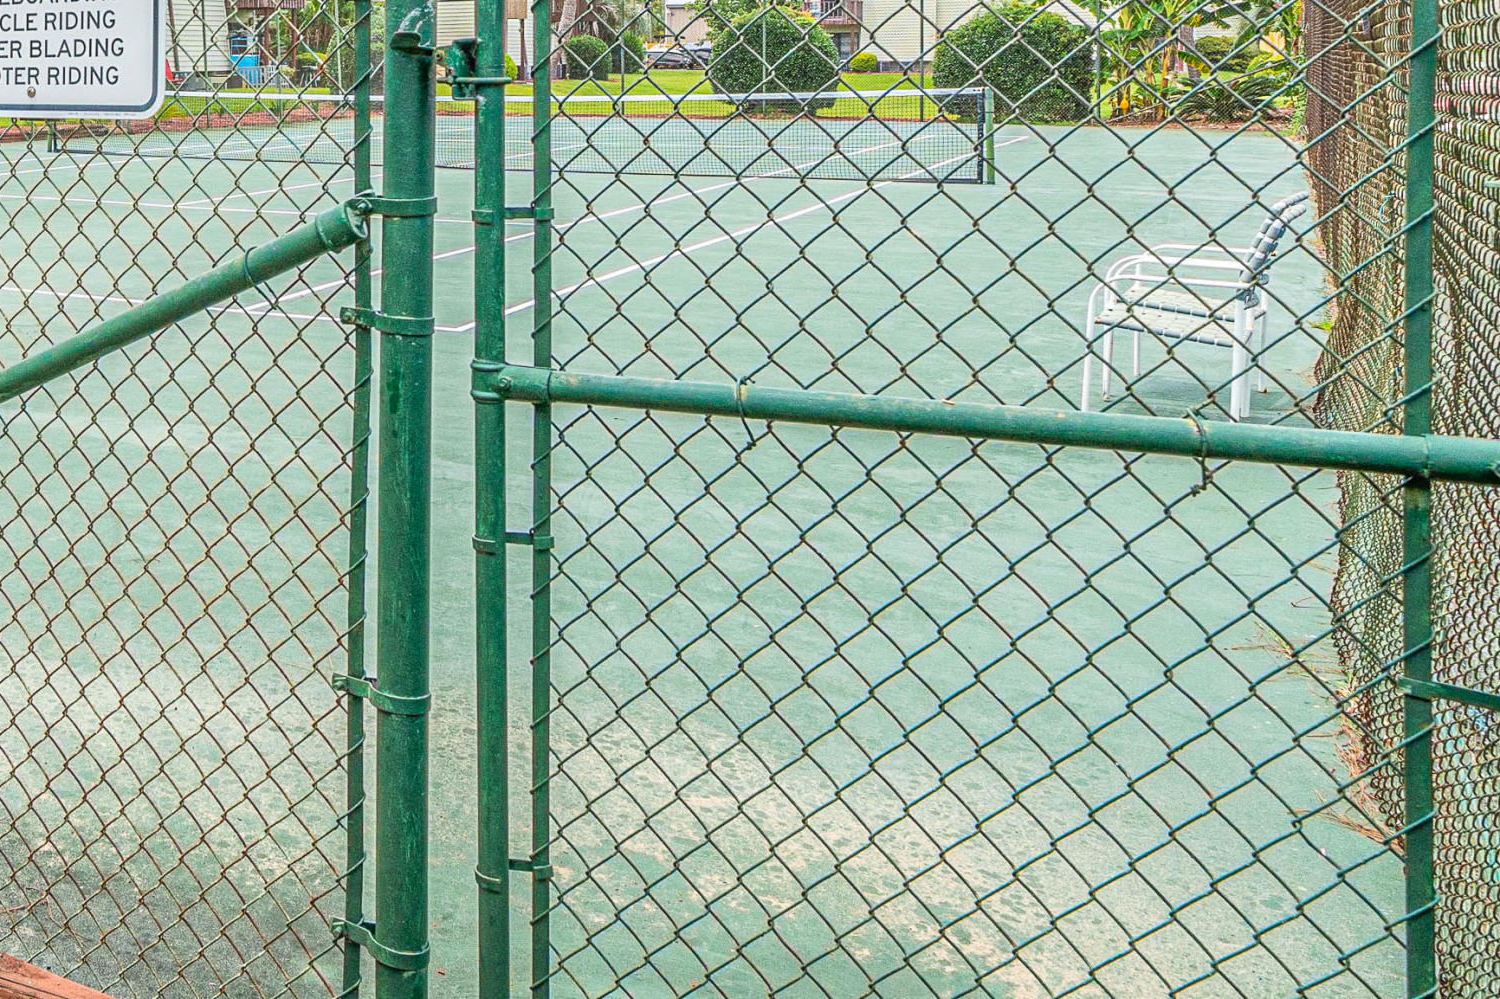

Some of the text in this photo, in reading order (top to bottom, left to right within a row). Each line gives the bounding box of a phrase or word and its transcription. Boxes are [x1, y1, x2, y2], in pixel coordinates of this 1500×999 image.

[44, 10, 116, 31] RIDING
[29, 37, 124, 58] BLADING
[47, 66, 119, 86] RIDING
